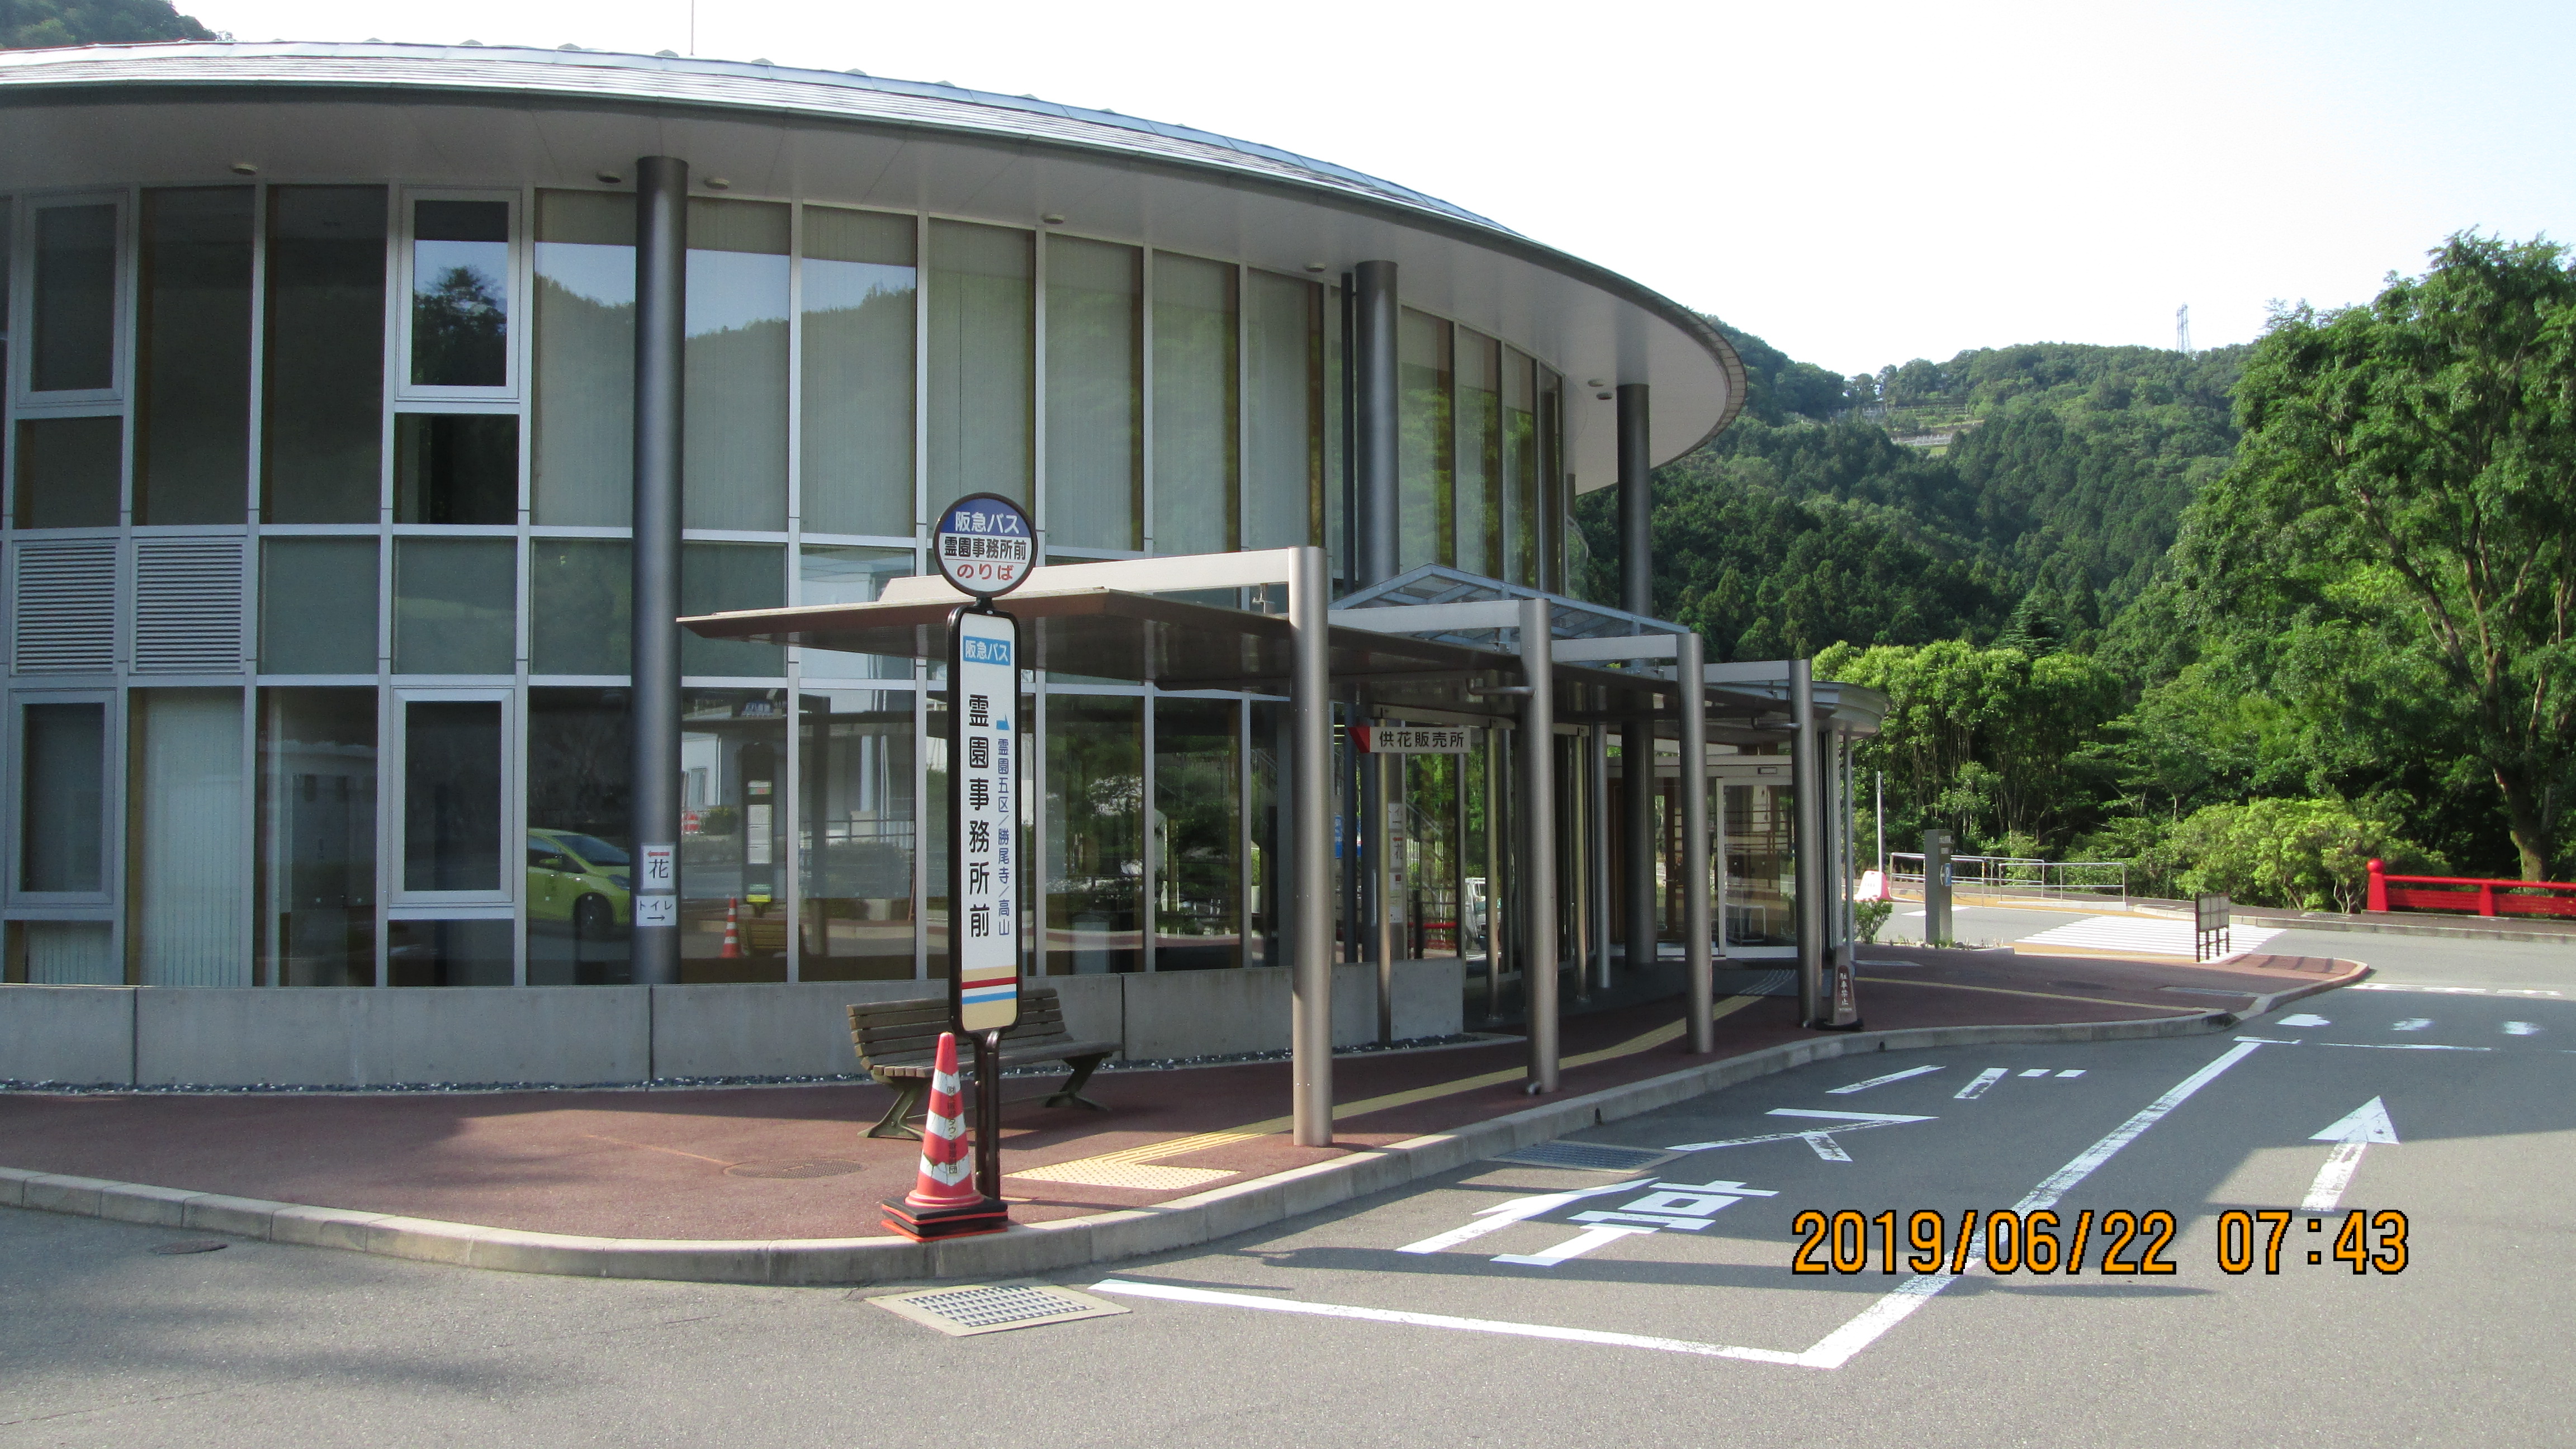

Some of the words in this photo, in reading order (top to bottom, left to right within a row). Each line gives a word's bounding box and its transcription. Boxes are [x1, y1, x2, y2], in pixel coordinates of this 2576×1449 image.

[955, 512, 1020, 534] 阪急バス
[944, 536, 1026, 561] 霊園事務所前
[957, 564, 1014, 580] のりば
[965, 640, 1009, 662] 阪急バス
[1380, 731, 1465, 747] 供花販売所
[969, 694, 990, 937] 霊園事務所前
[648, 859, 669, 878] 花
[640, 900, 673, 911] トイレ
